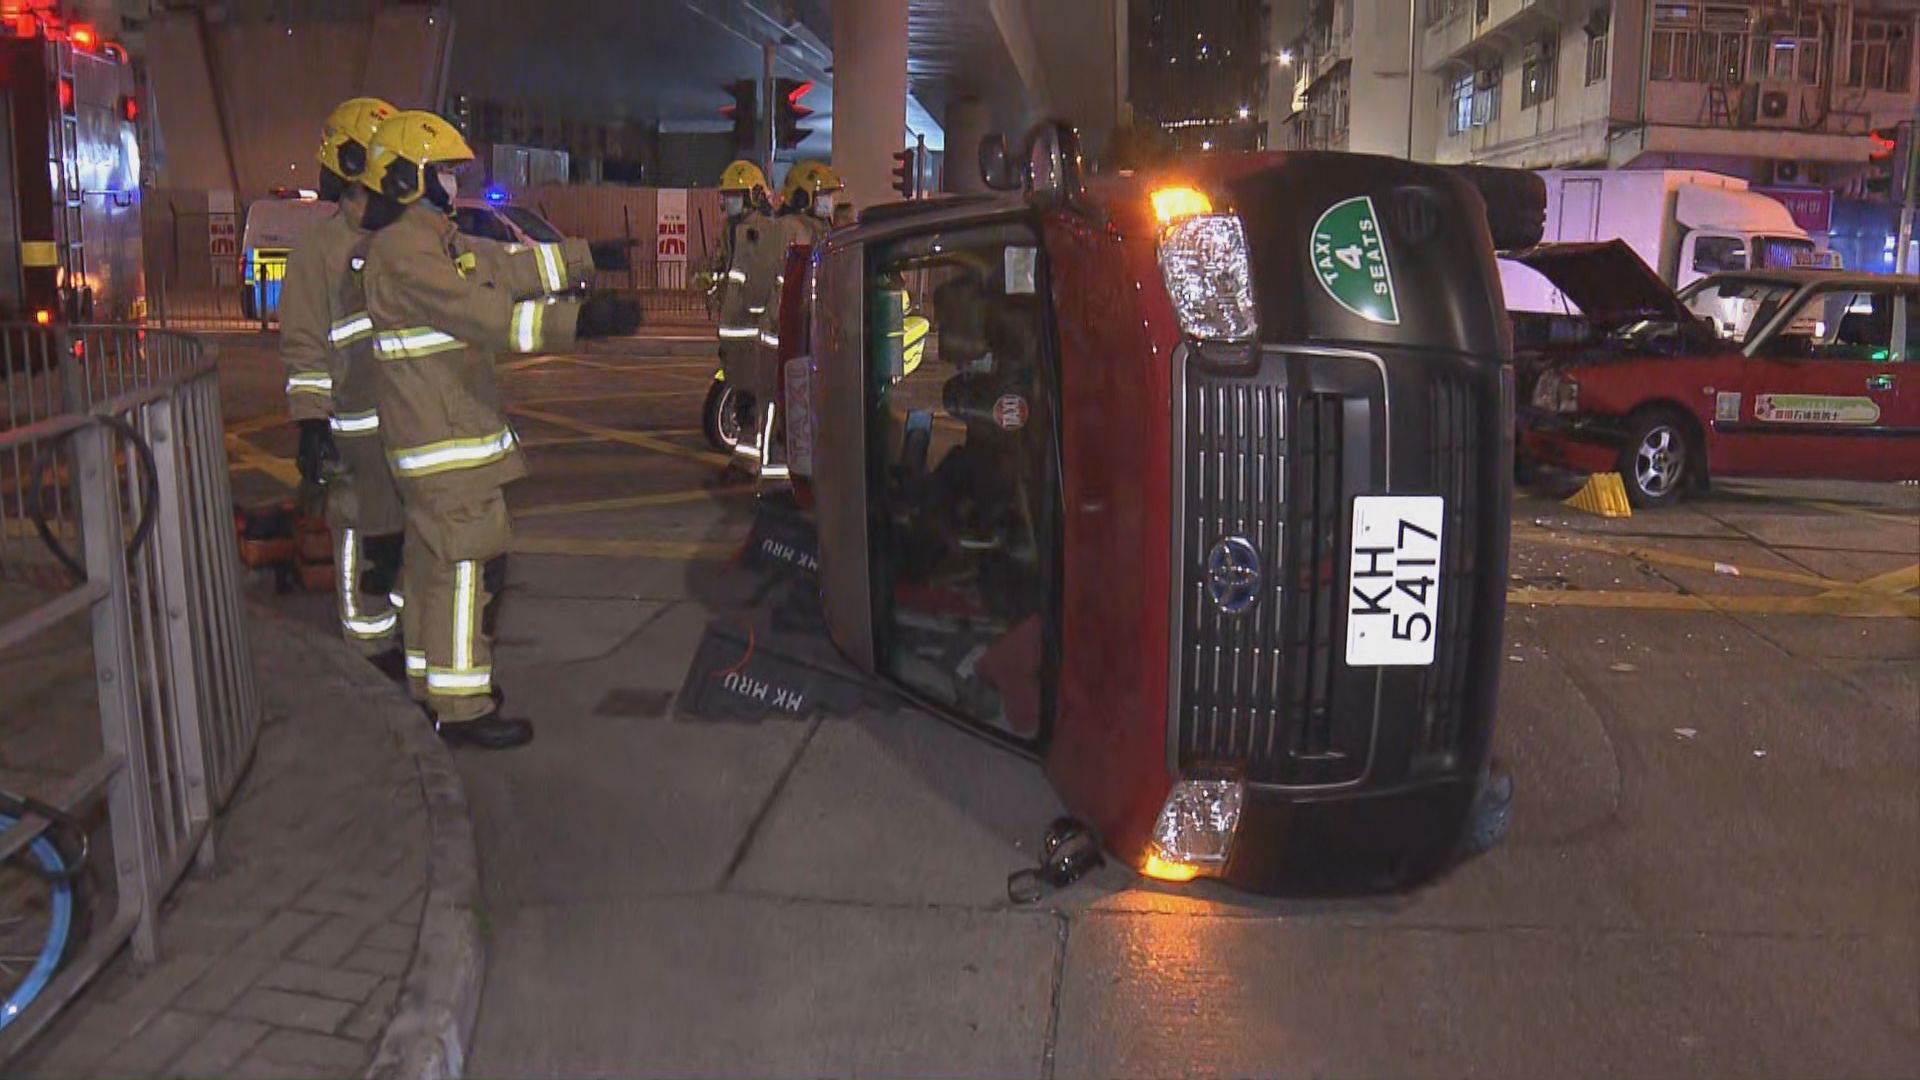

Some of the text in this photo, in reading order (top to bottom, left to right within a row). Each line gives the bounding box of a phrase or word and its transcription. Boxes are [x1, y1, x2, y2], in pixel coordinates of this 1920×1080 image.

[1315, 233, 1339, 286] TAXI
[1335, 244, 1363, 270] 4
[1359, 219, 1388, 295] SEATS
[761, 538, 795, 562] MRU
[1351, 546, 1395, 615] KH
[1391, 518, 1438, 643] 5417
[723, 672, 804, 712] MK MRU
